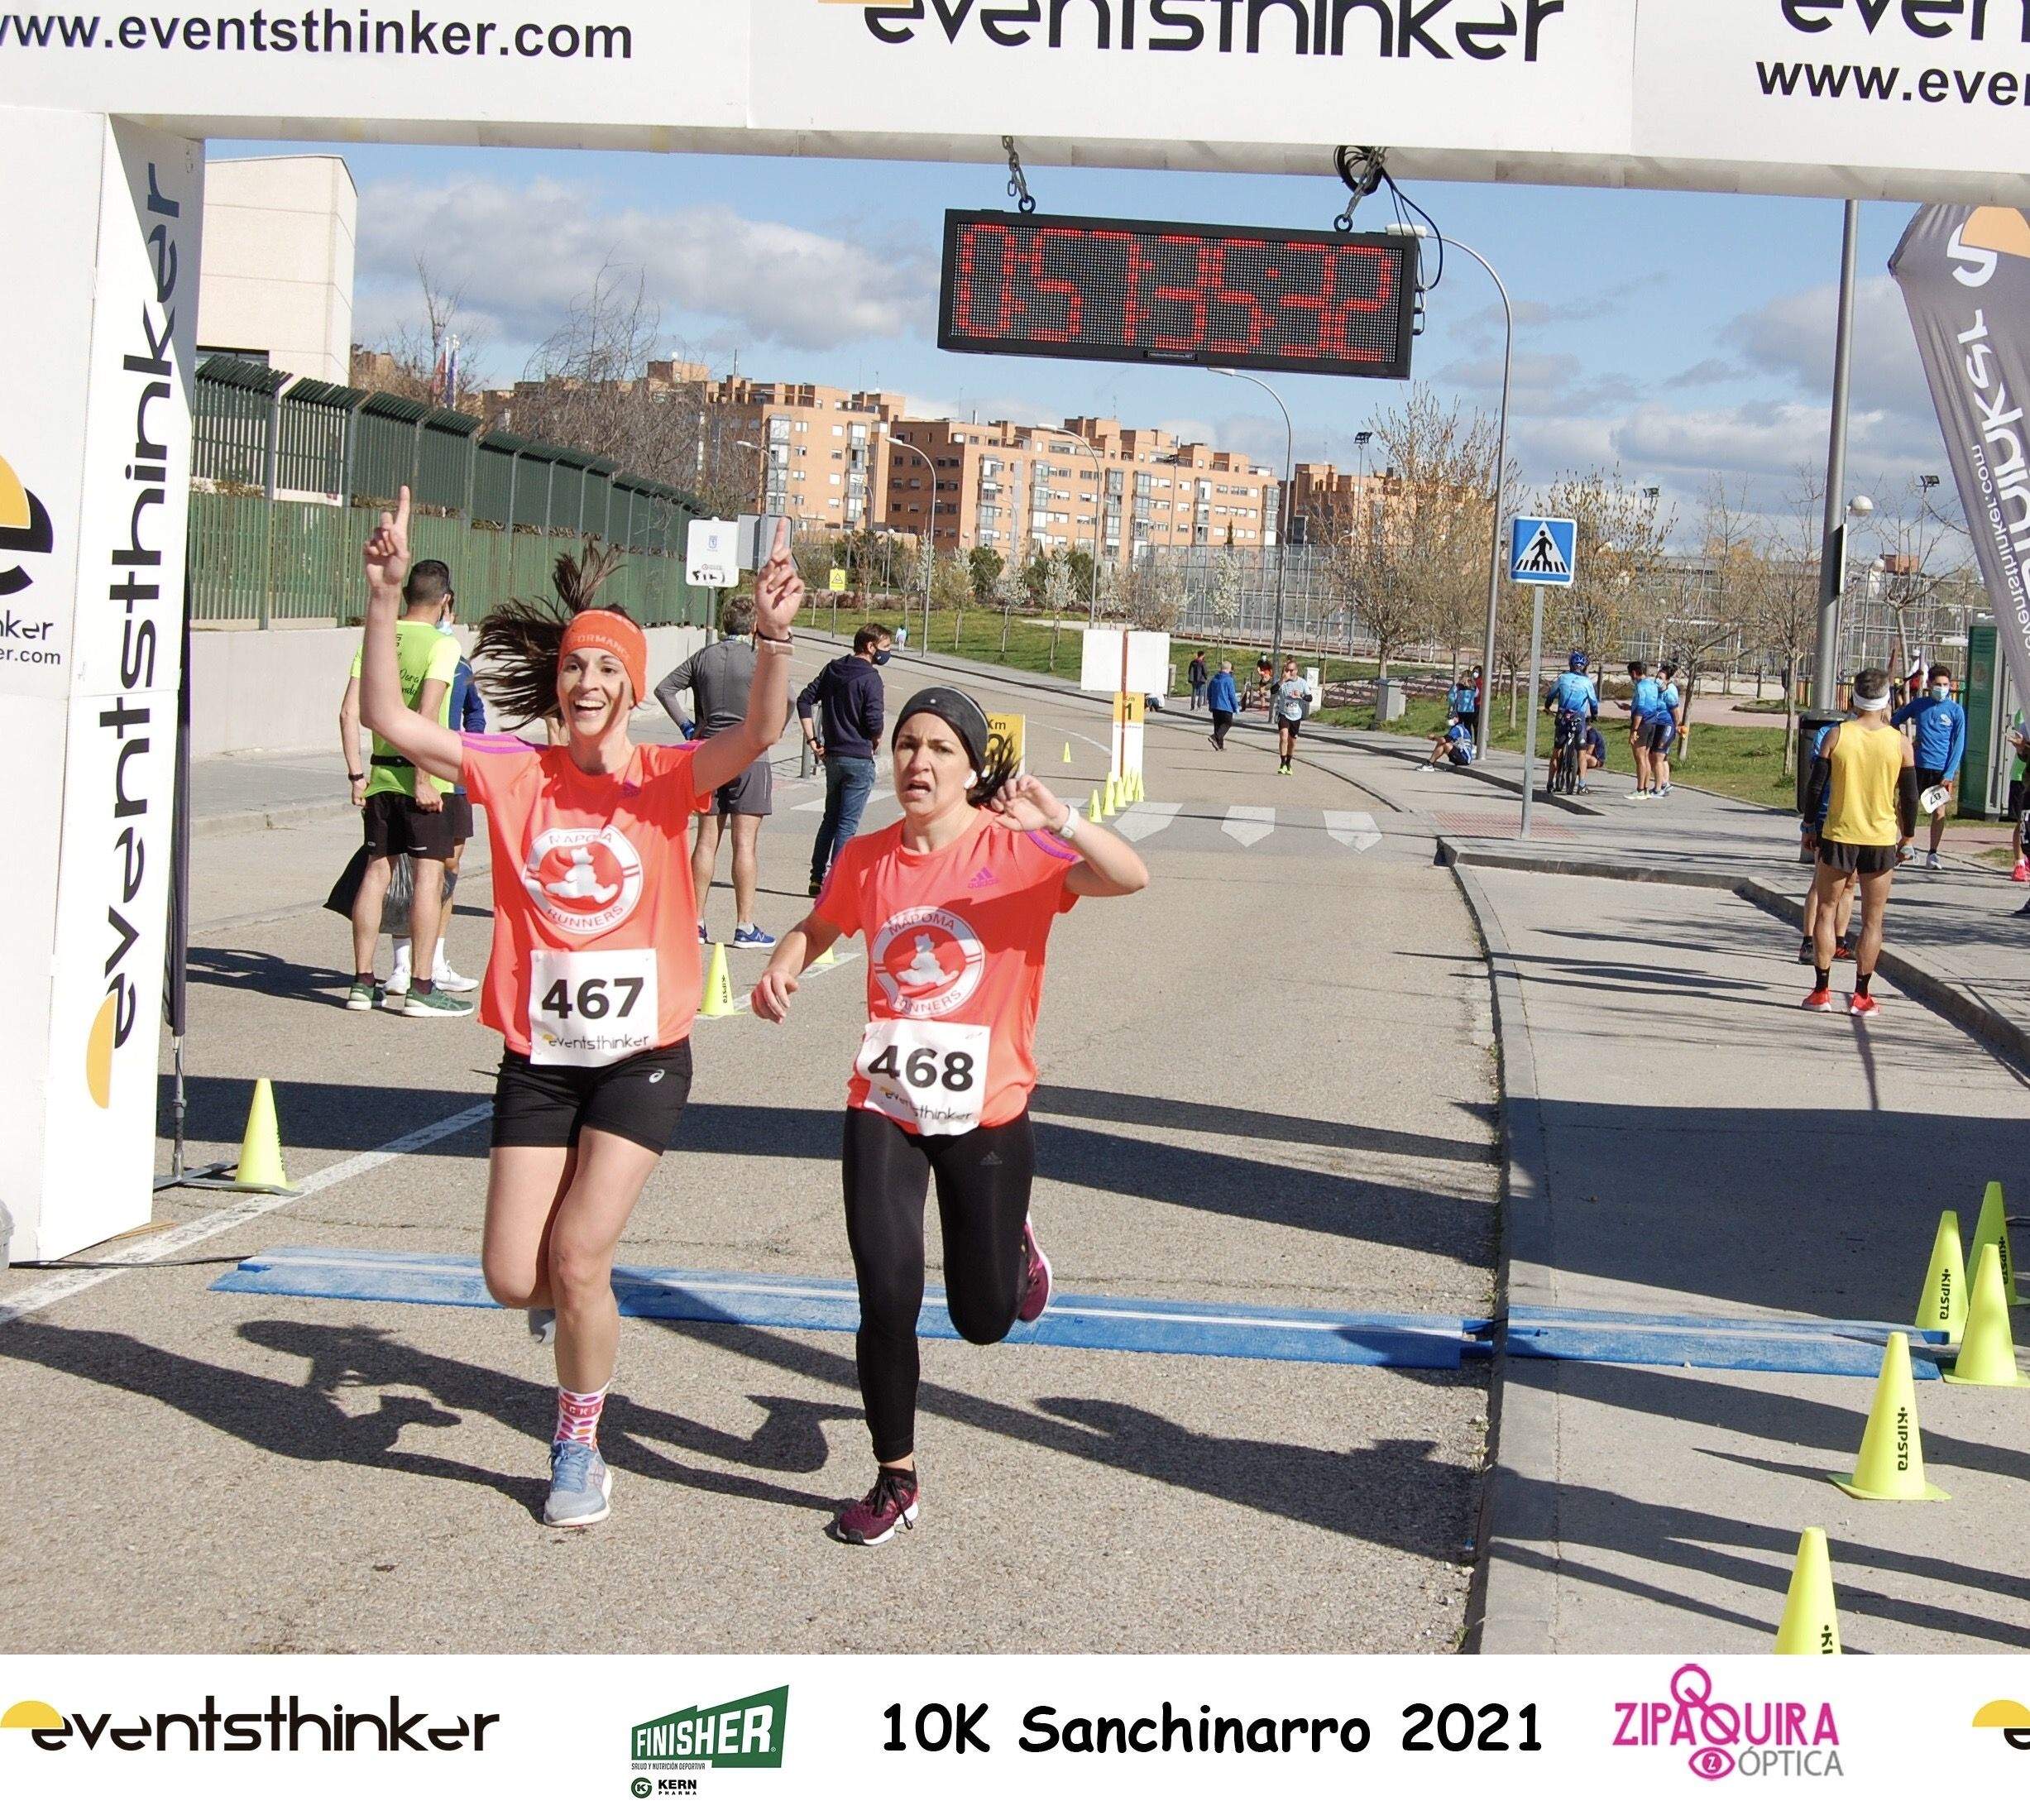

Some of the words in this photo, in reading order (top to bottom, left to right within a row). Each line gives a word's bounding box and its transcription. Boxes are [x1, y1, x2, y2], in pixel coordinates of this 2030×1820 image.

[0, 10, 632, 58] ww.eventsthinker.com
[99, 162, 180, 1049] eventsthinker
[547, 904, 624, 927] RUNNERS
[888, 912, 955, 936] MAPOMA
[542, 977, 644, 1019] 467
[548, 1034, 650, 1050] eventsthinker
[868, 1045, 974, 1092] 468
